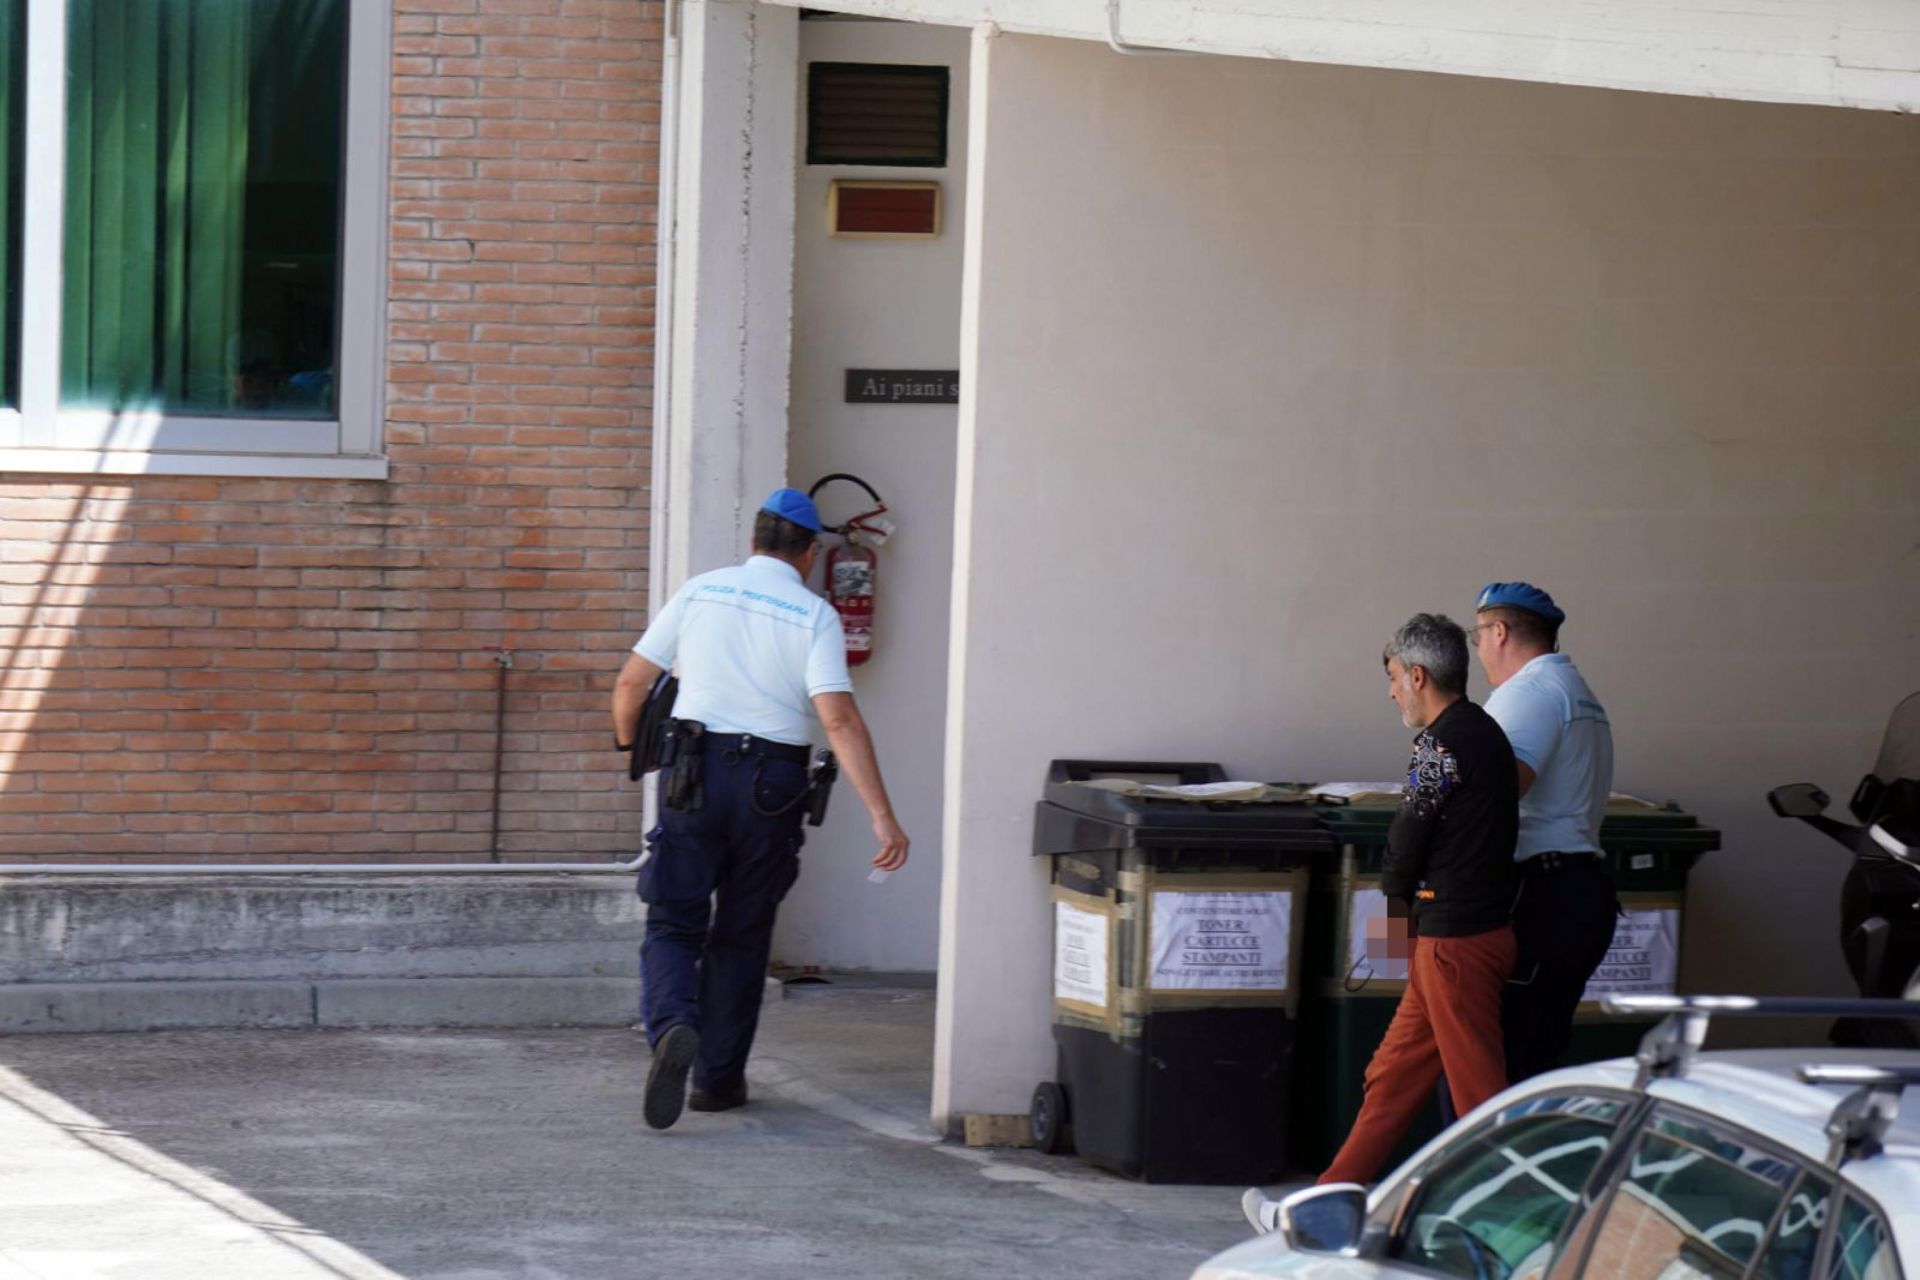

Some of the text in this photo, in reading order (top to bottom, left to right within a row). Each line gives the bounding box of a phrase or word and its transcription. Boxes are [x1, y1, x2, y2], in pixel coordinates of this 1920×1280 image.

[862, 378, 887, 396] Ai
[892, 378, 944, 400] piani
[1182, 951, 1262, 963] STAMPANTI
